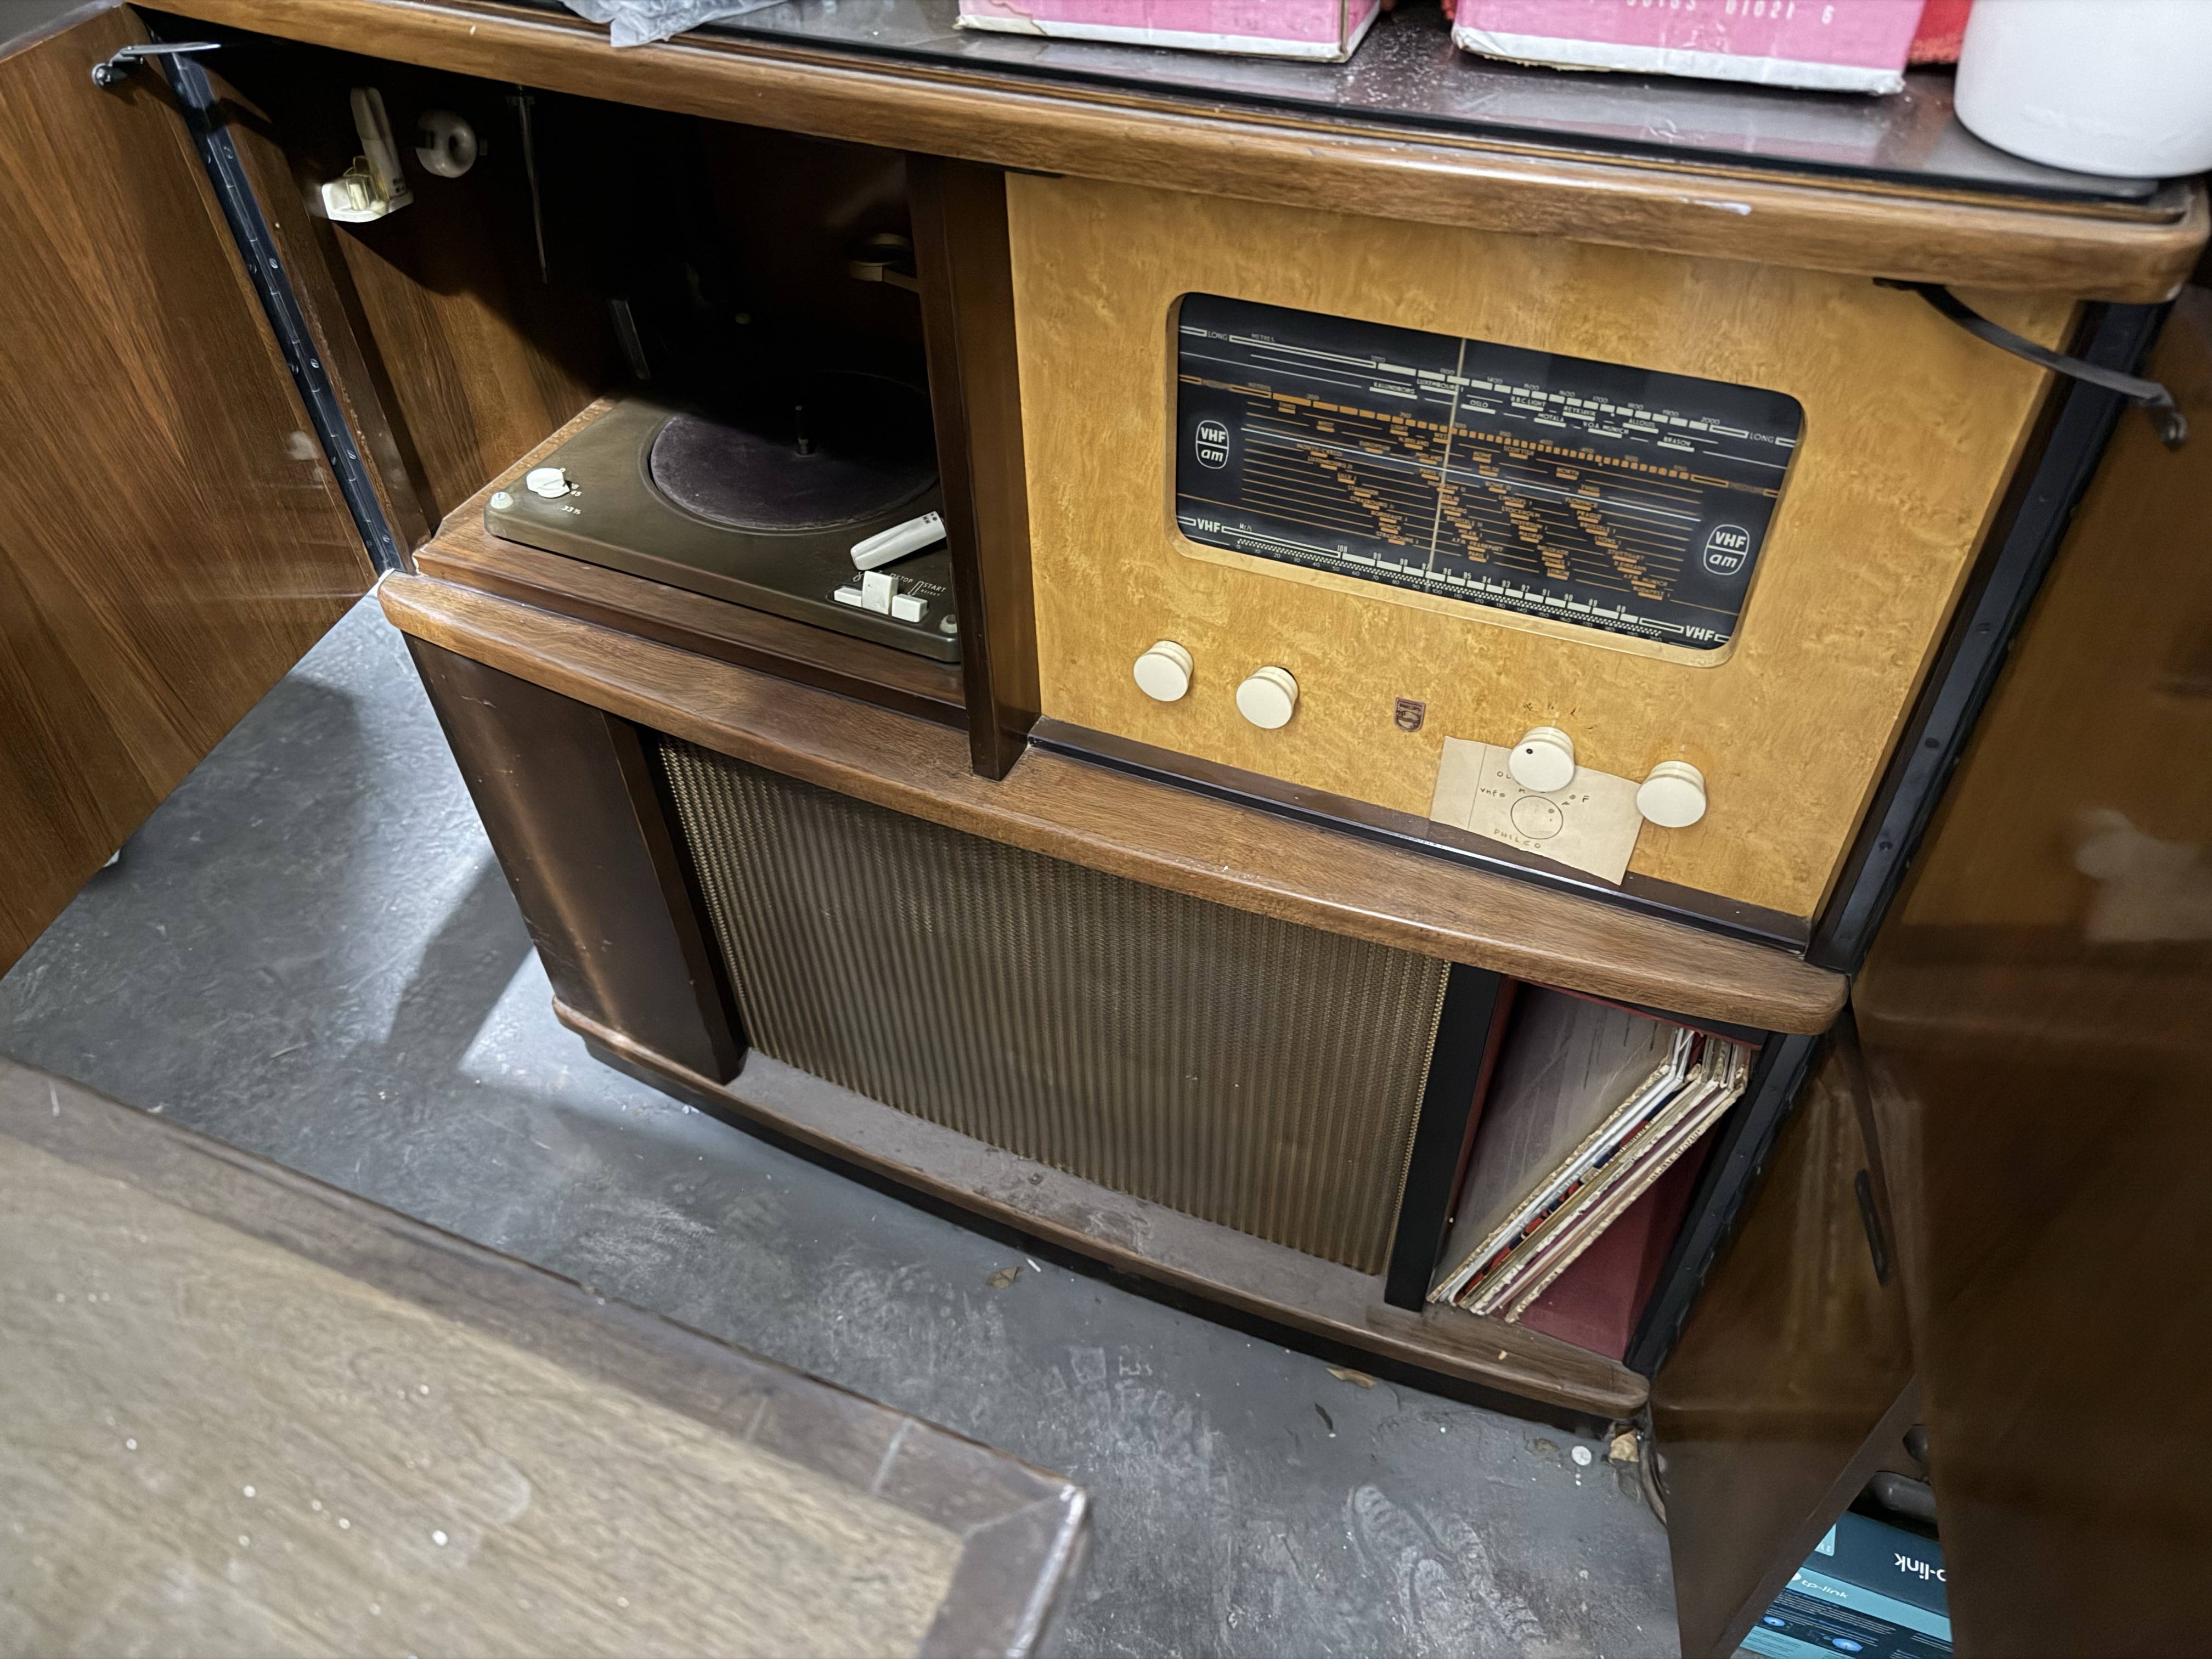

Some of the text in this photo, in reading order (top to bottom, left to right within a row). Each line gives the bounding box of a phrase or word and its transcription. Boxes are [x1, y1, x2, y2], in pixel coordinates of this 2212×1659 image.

[1821, 5, 1834, 24] 6
[1207, 331, 1227, 340] LONG
[1251, 333, 1275, 342] METRES
[1538, 413, 1564, 422] MOTALA
[1201, 427, 1226, 443] VHF
[1701, 417, 1720, 425] 2000
[1750, 432, 1775, 443] LONG
[1201, 449, 1223, 462] am
[1197, 518, 1220, 533] VHF
[1716, 531, 1746, 548] VHF
[1709, 554, 1738, 568] am
[896, 575, 913, 583] STOP
[923, 583, 946, 592] START
[1338, 544, 1347, 553] 100
[1373, 552, 1381, 560] 99
[1400, 558, 1408, 566] 98
[1521, 584, 1530, 592] 92
[1686, 625, 1715, 641] VHF
[1494, 828, 1541, 849] PHILCO
[1801, 1579, 1849, 1599] tp-link
